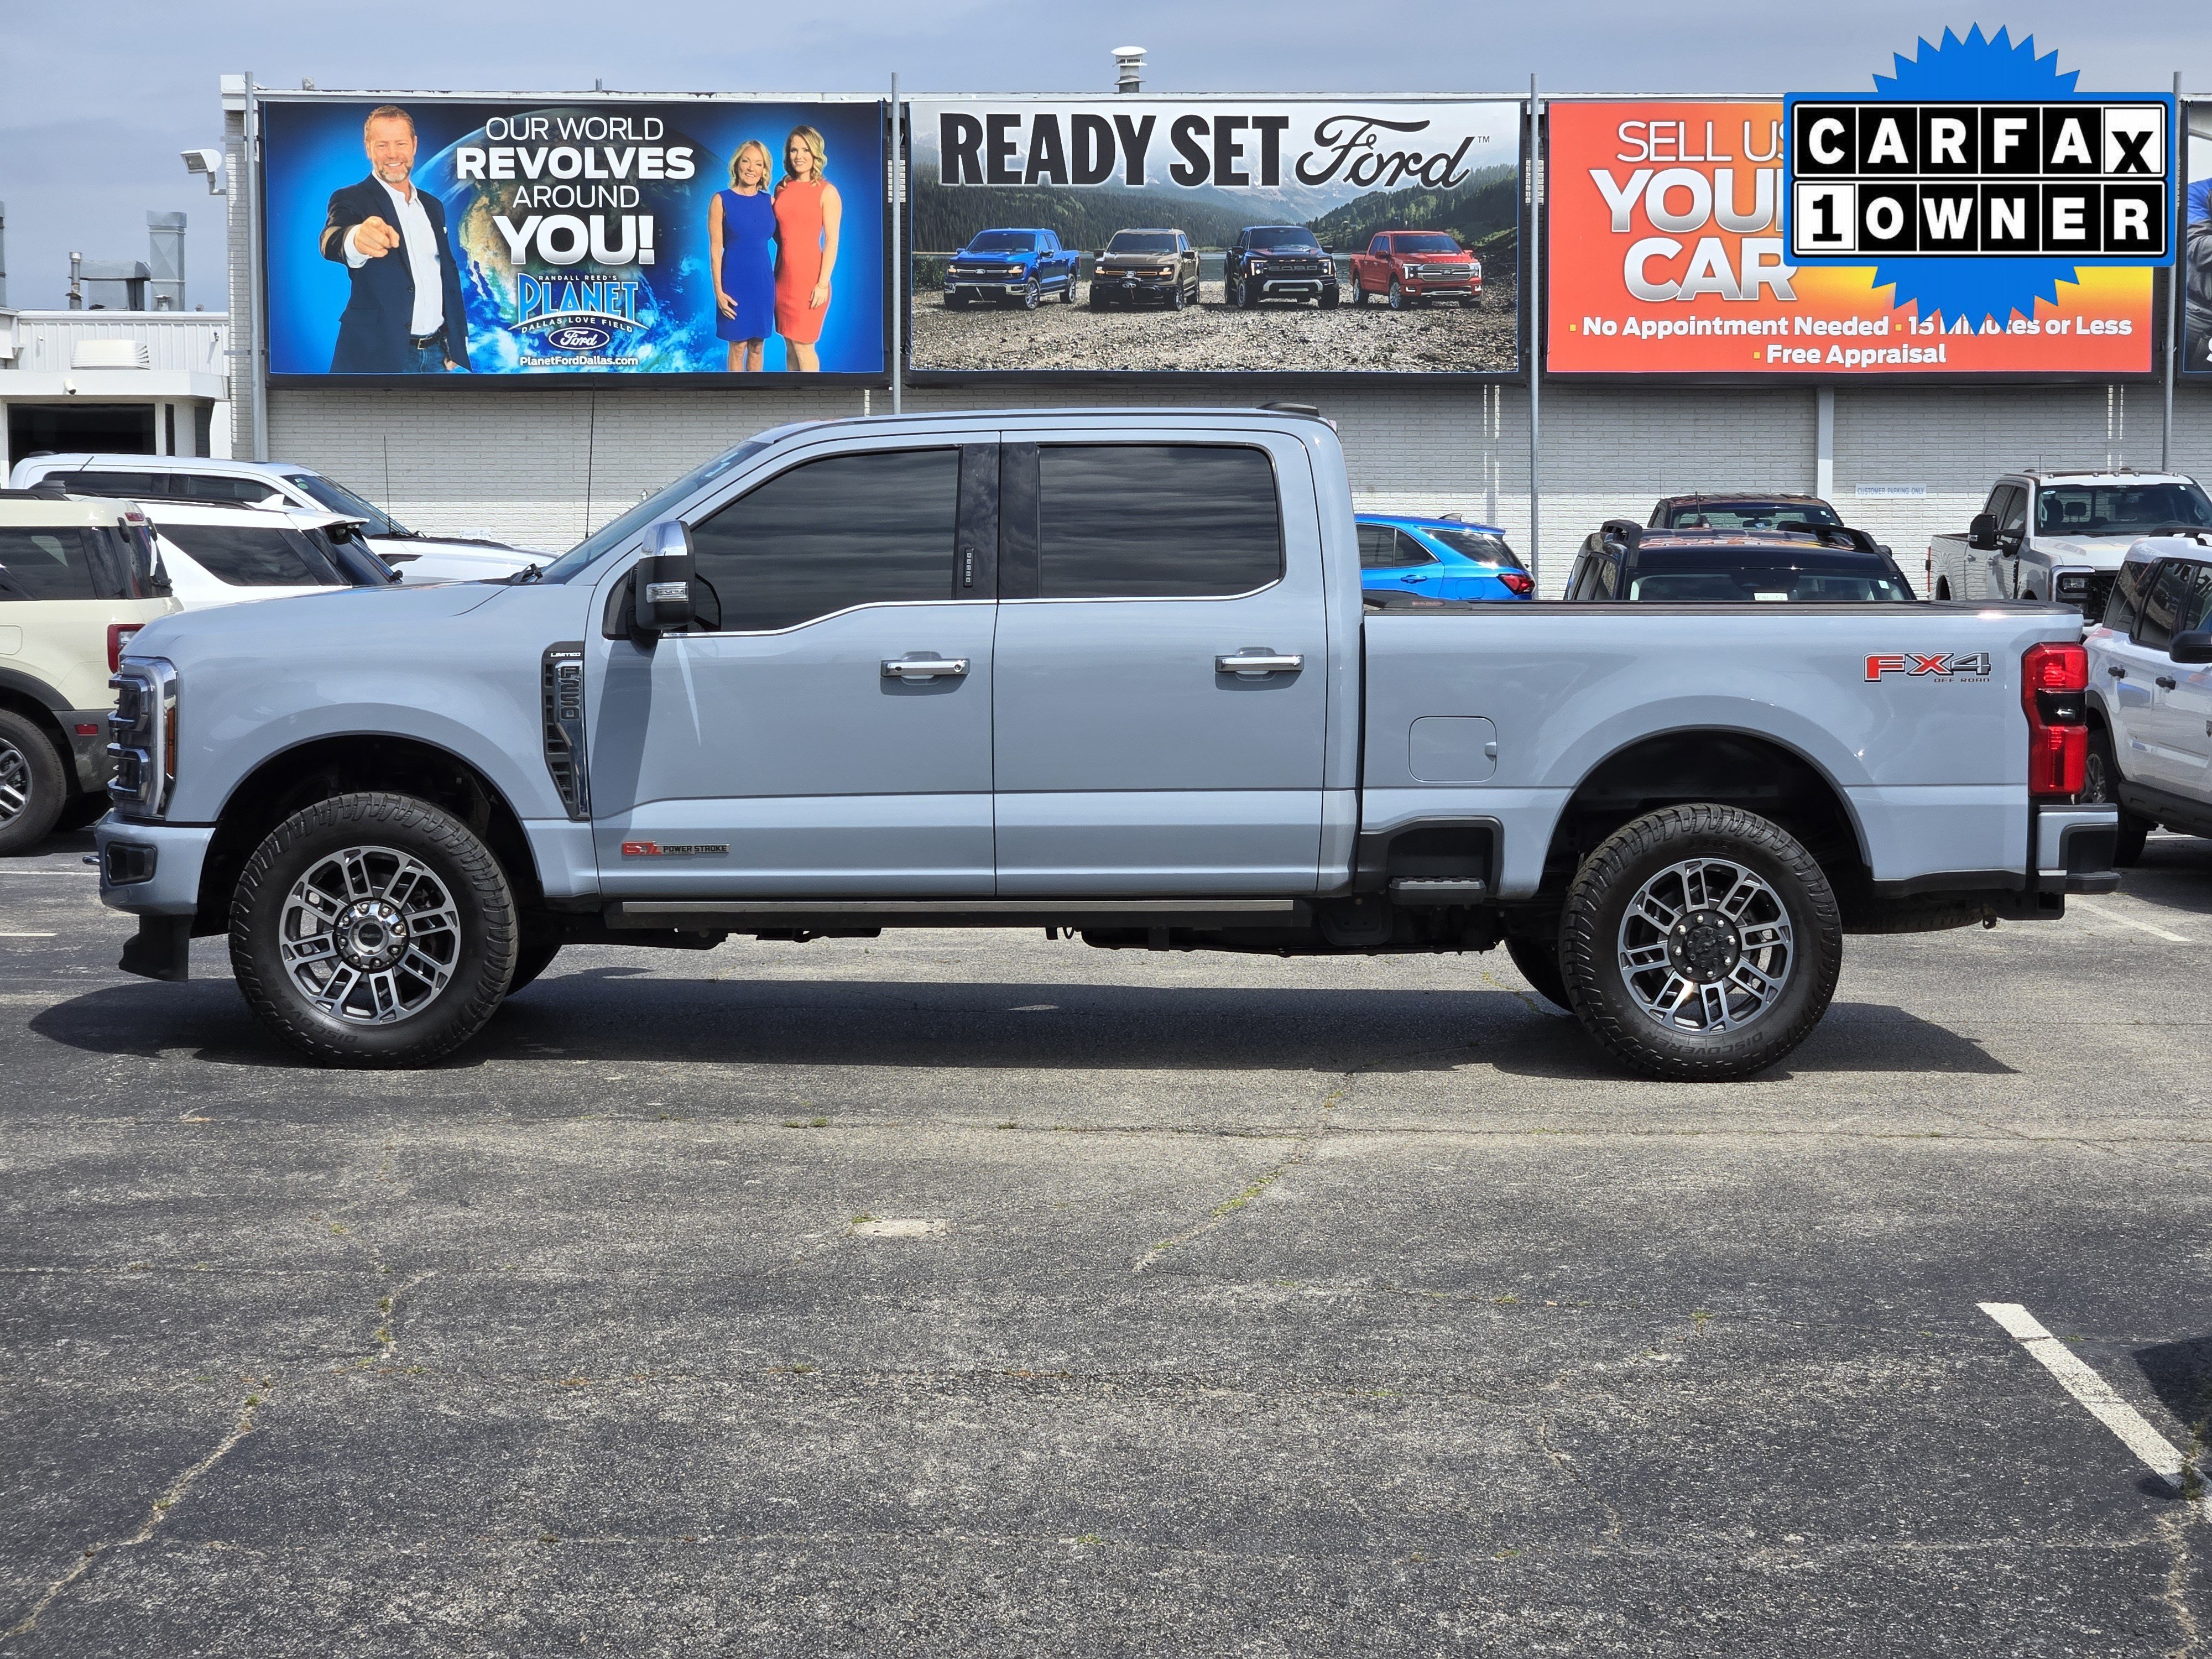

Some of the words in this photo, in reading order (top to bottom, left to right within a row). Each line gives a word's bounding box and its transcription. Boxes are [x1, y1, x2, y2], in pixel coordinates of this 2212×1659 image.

[486, 117, 549, 140] OUR
[556, 117, 664, 140] WORLD
[1616, 120, 1733, 163] SELL
[1743, 121, 1784, 162] U
[456, 146, 696, 180] REVOLVES
[940, 113, 1157, 186] READY
[1170, 114, 1289, 187] SET
[1295, 115, 1475, 188] Ford
[512, 185, 640, 208] AROUND
[1589, 168, 1784, 233] YOU
[492, 213, 655, 265] YOU!
[1624, 237, 1797, 302] CAR
[517, 273, 639, 324] PLANET
[521, 317, 562, 333] DALLAS
[602, 319, 633, 333] FIELD
[560, 329, 598, 346] Ford
[1582, 316, 1618, 336] No
[1622, 316, 1788, 340] Appointment
[1794, 316, 1889, 336] Needed
[1908, 316, 1934, 335] 15
[2045, 319, 2071, 335] or
[2076, 316, 2133, 336] Less
[520, 356, 639, 366] PlanetFordDallas.com
[1767, 344, 1822, 363] Free
[1825, 343, 1947, 368] Appraisal
[1864, 653, 1992, 684] FX4
